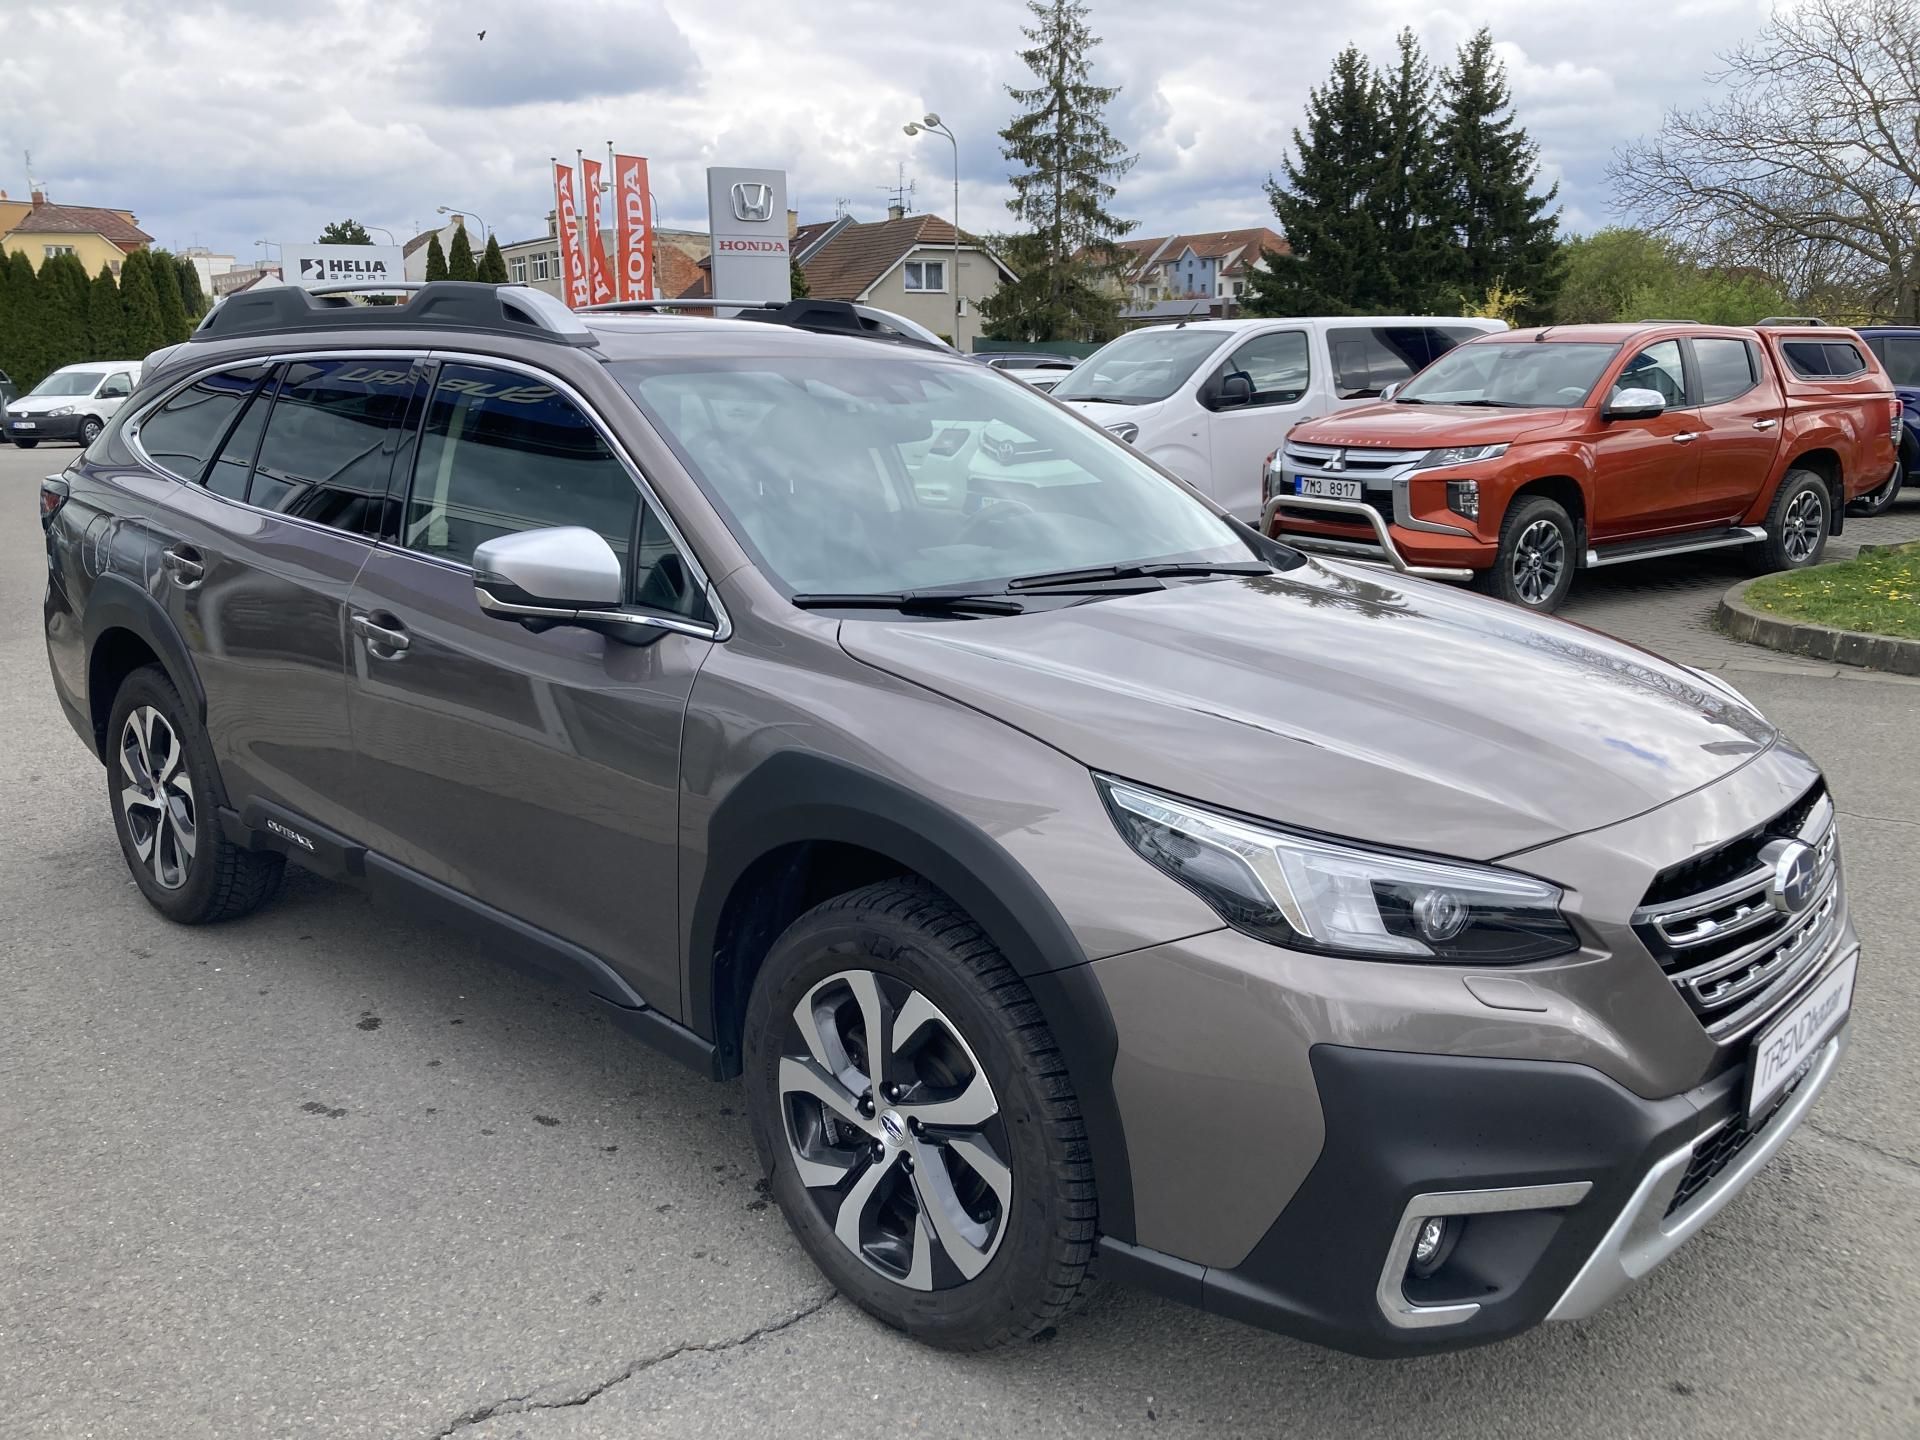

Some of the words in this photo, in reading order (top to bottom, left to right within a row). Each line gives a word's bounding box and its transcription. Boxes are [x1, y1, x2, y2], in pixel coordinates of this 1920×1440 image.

[624, 162, 646, 301] HONDA
[719, 240, 786, 252] HONDA
[329, 260, 387, 272] HELIA
[1303, 479, 1322, 494] 7M3
[1329, 481, 1356, 497] 8917
[267, 819, 314, 850] OUTBACK
